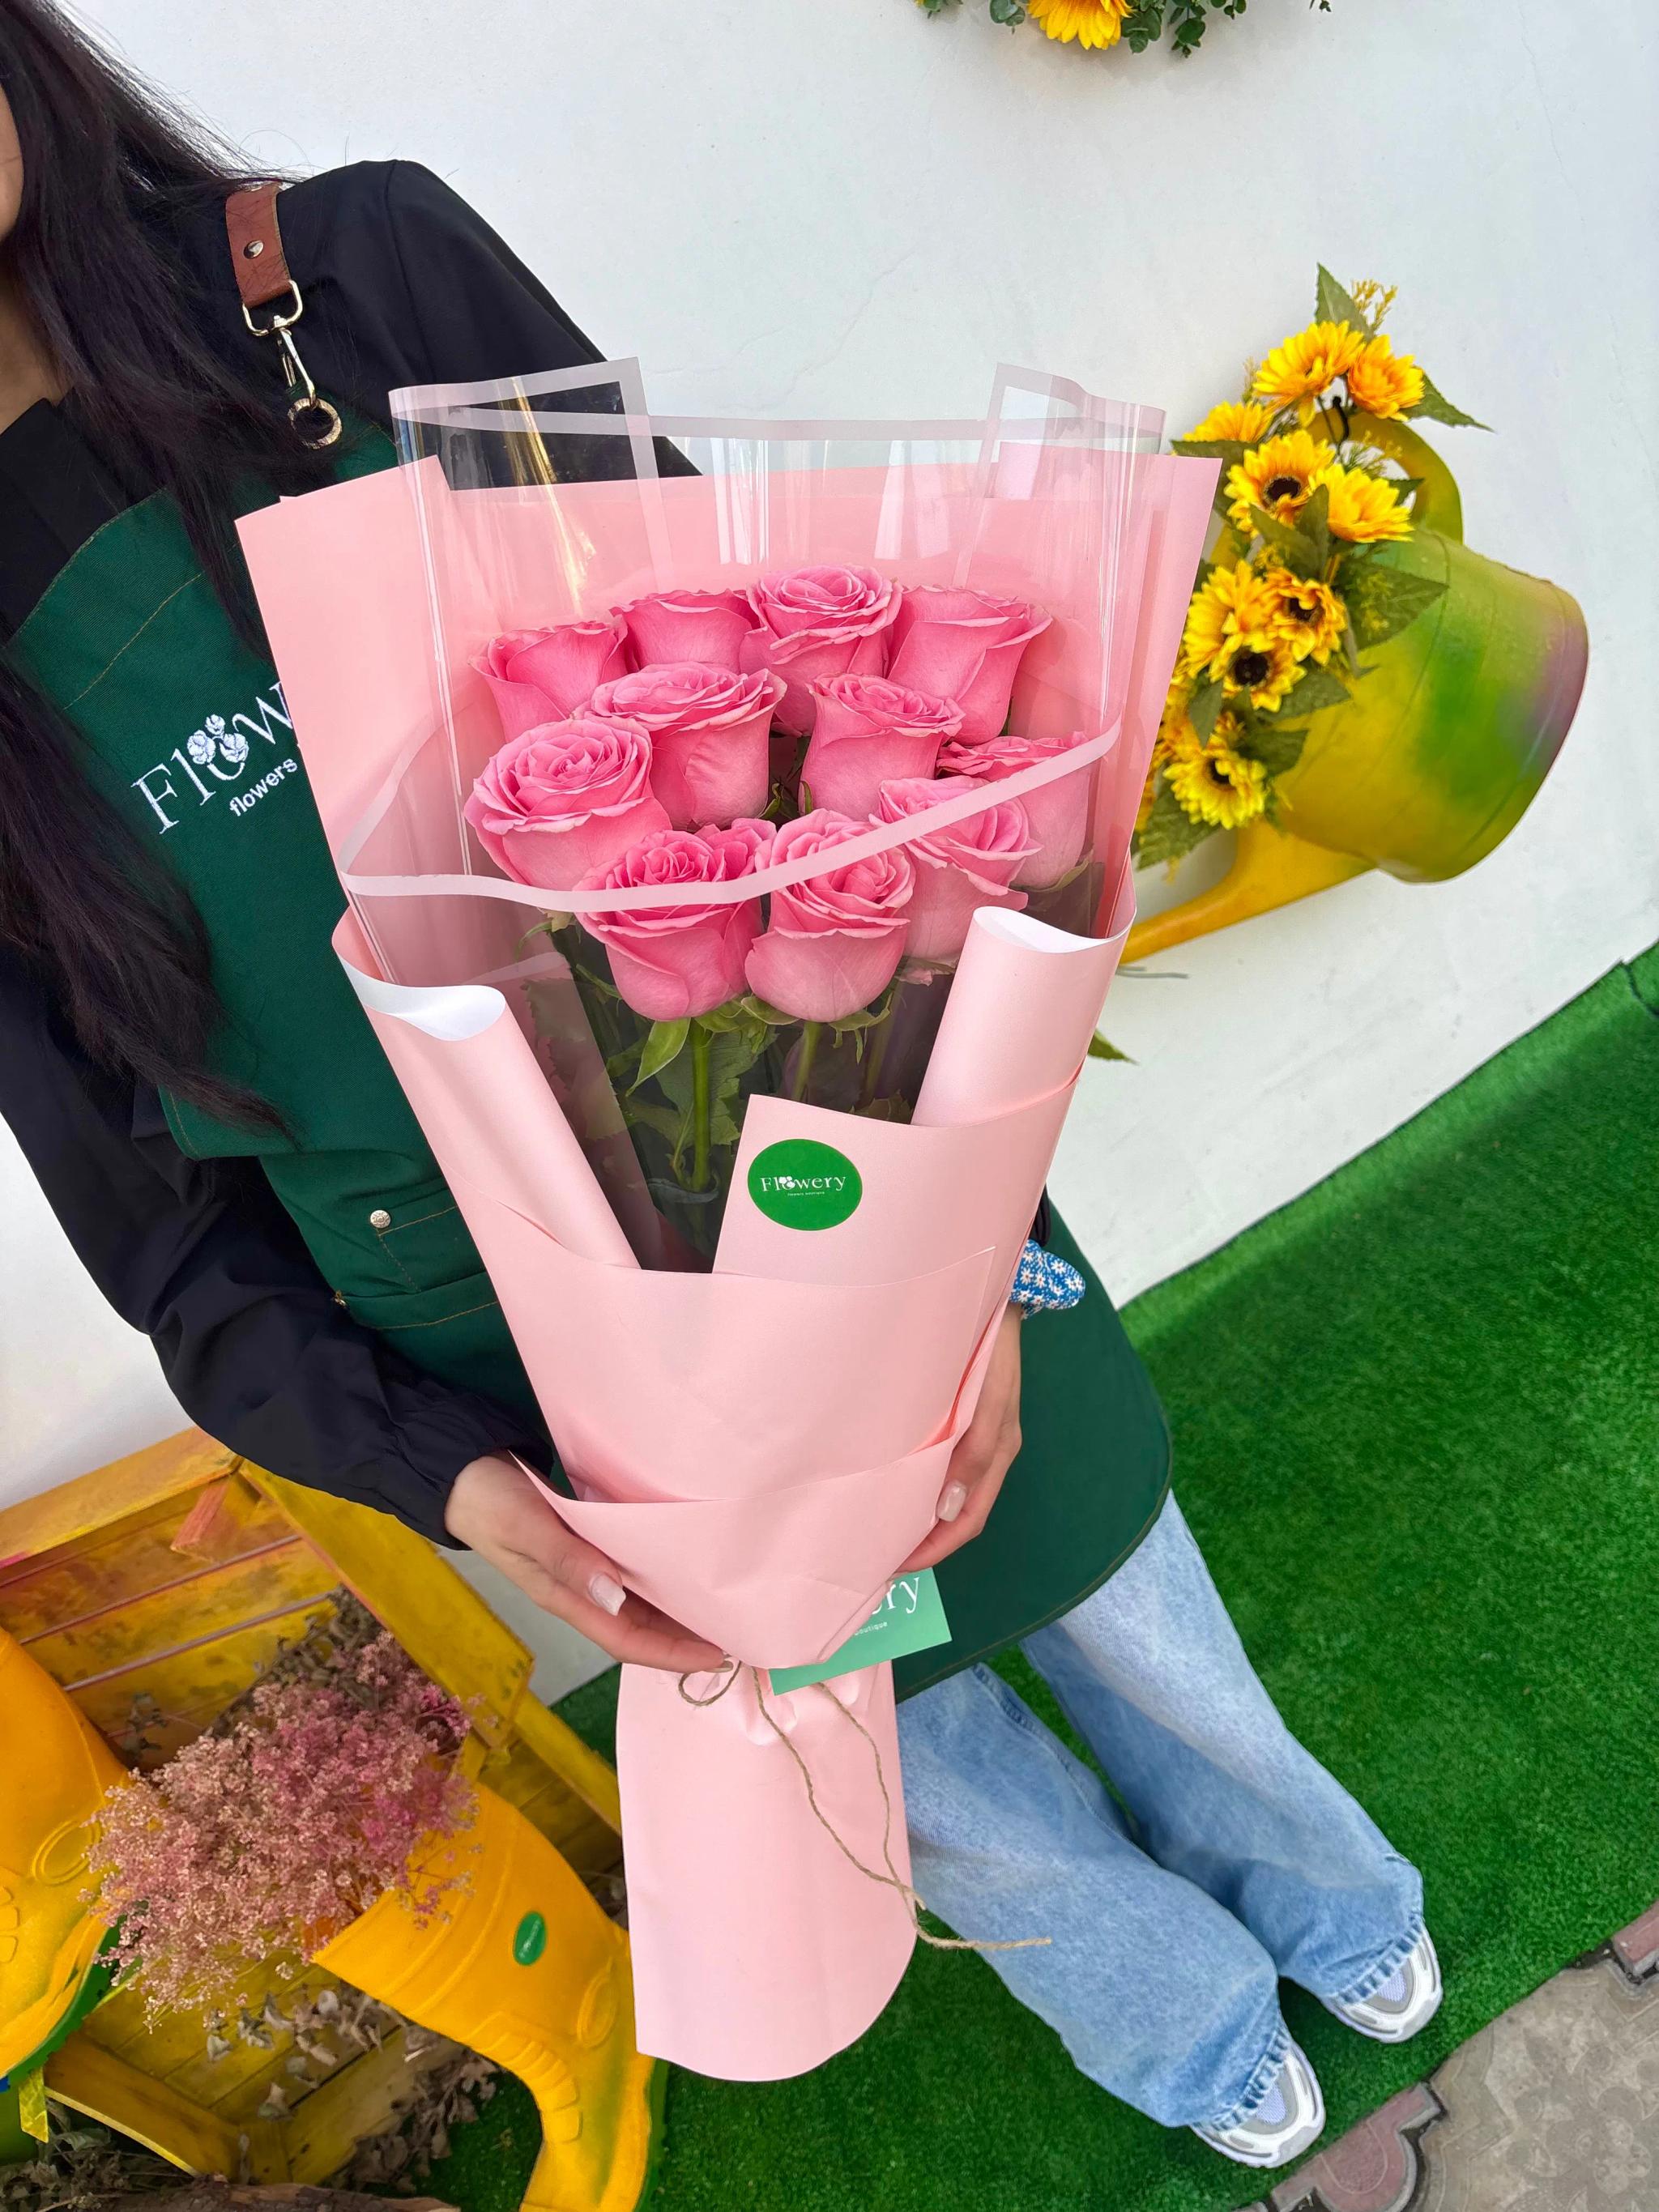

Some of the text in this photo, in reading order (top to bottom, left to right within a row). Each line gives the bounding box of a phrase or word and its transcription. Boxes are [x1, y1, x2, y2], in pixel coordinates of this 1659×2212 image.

[229, 758, 297, 816] flowers
[760, 1175, 847, 1192] Flowery
[872, 1576, 920, 1614] ry
